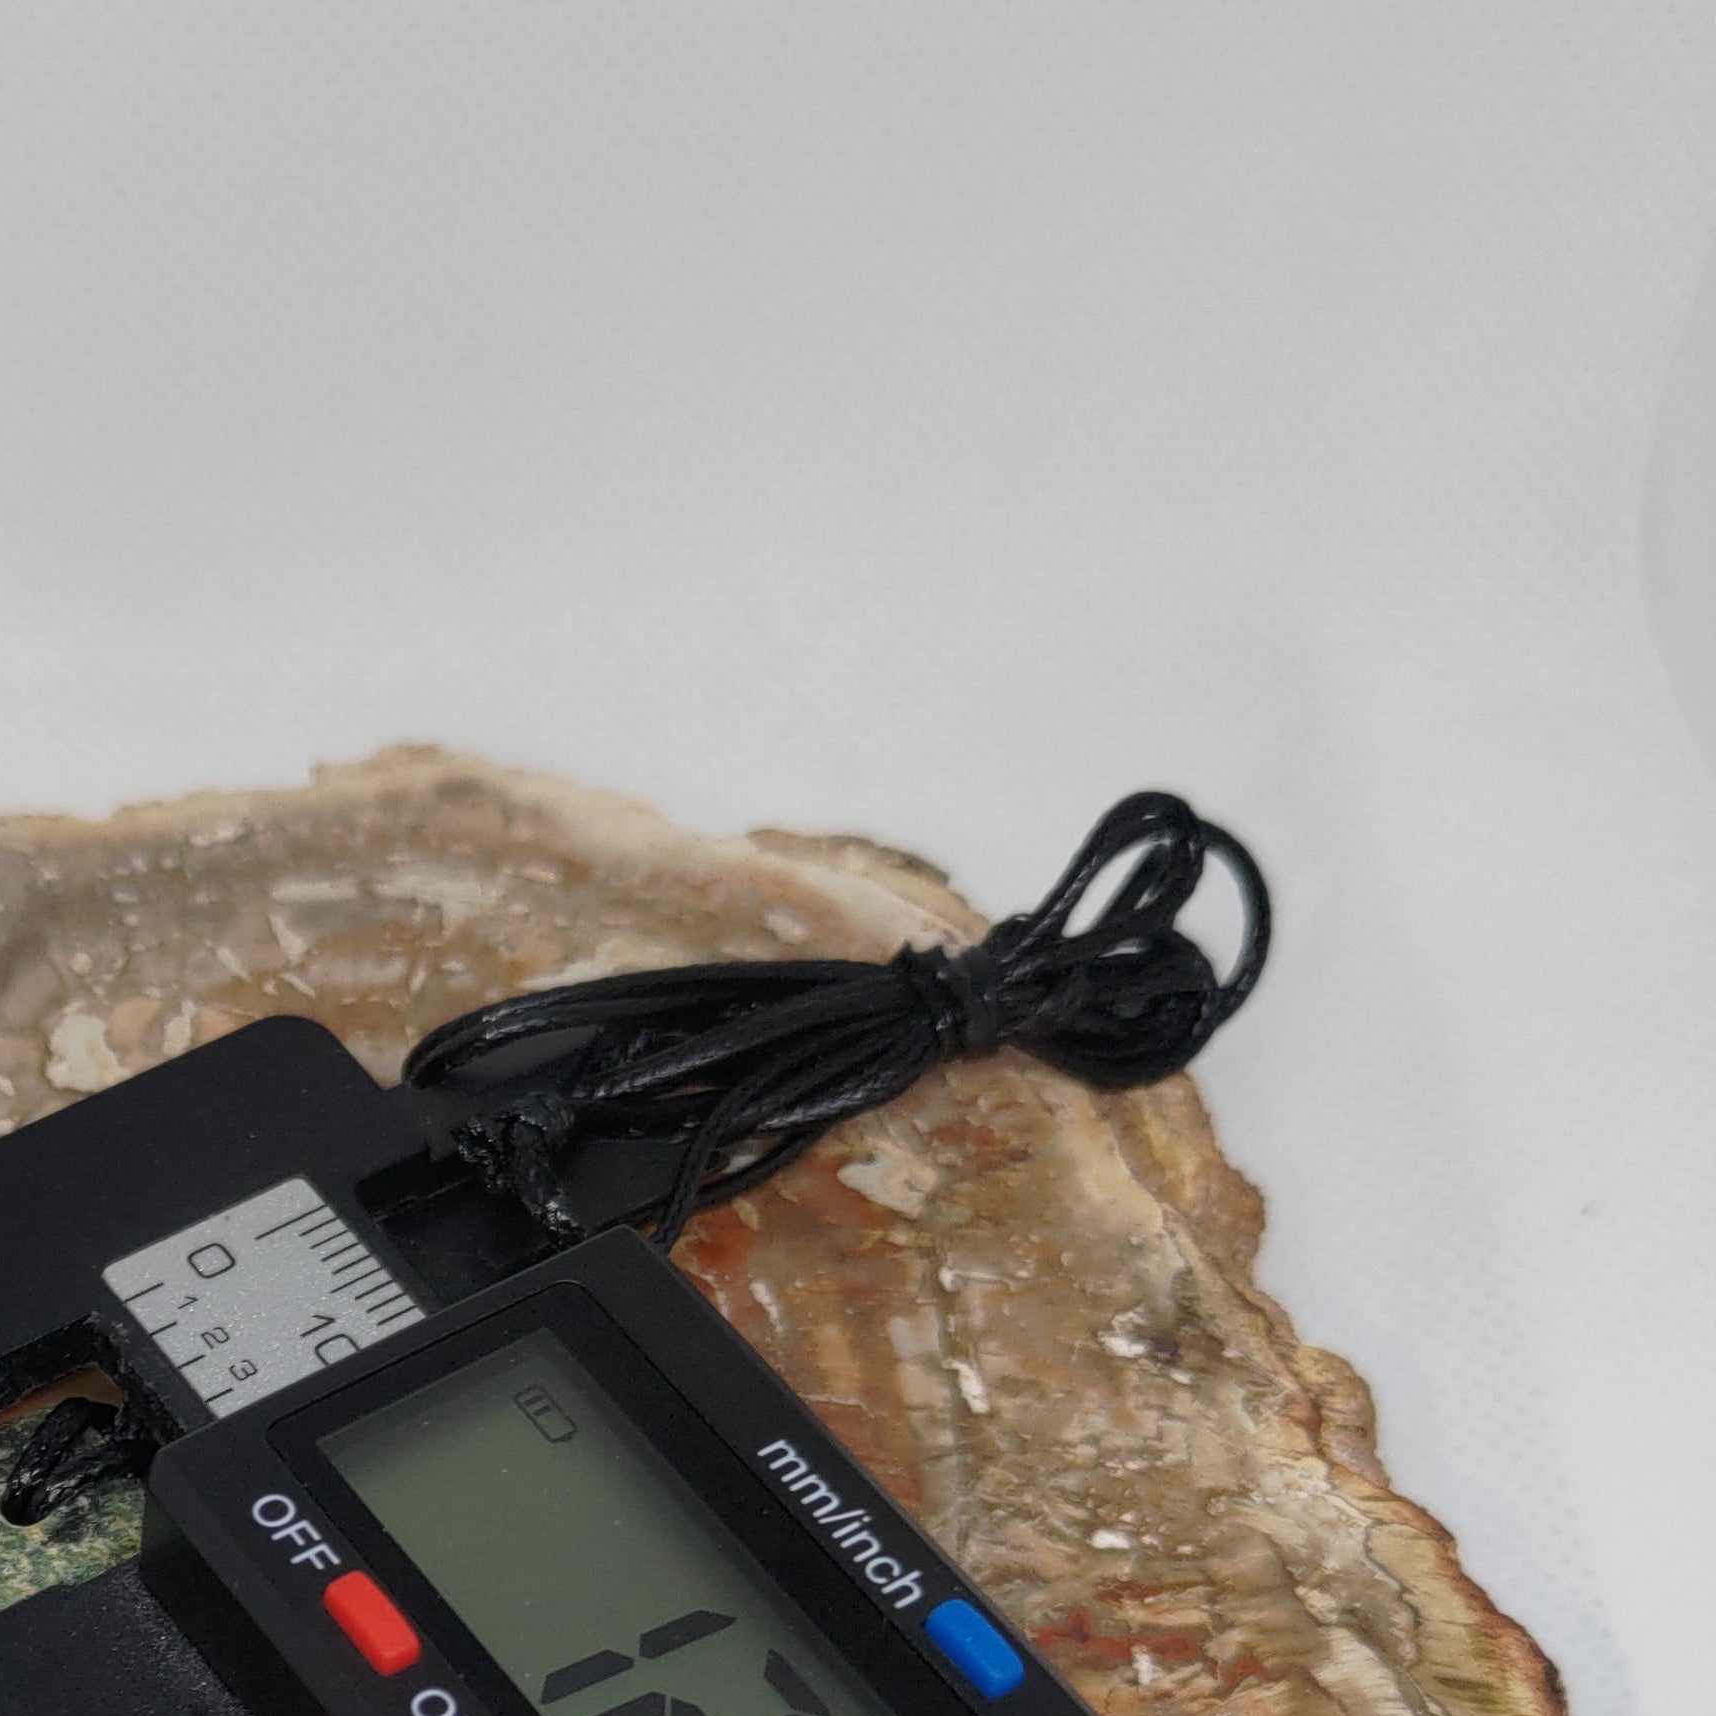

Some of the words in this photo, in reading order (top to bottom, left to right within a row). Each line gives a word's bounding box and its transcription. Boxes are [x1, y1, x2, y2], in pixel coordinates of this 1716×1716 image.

[177, 1295, 199, 1310] 1
[200, 1325, 230, 1350] 2
[228, 1358, 259, 1381] 3
[188, 1243, 236, 1279] 0
[300, 1313, 361, 1366] 10
[251, 1493, 341, 1574] OFF
[756, 1438, 929, 1610] mm/inch
